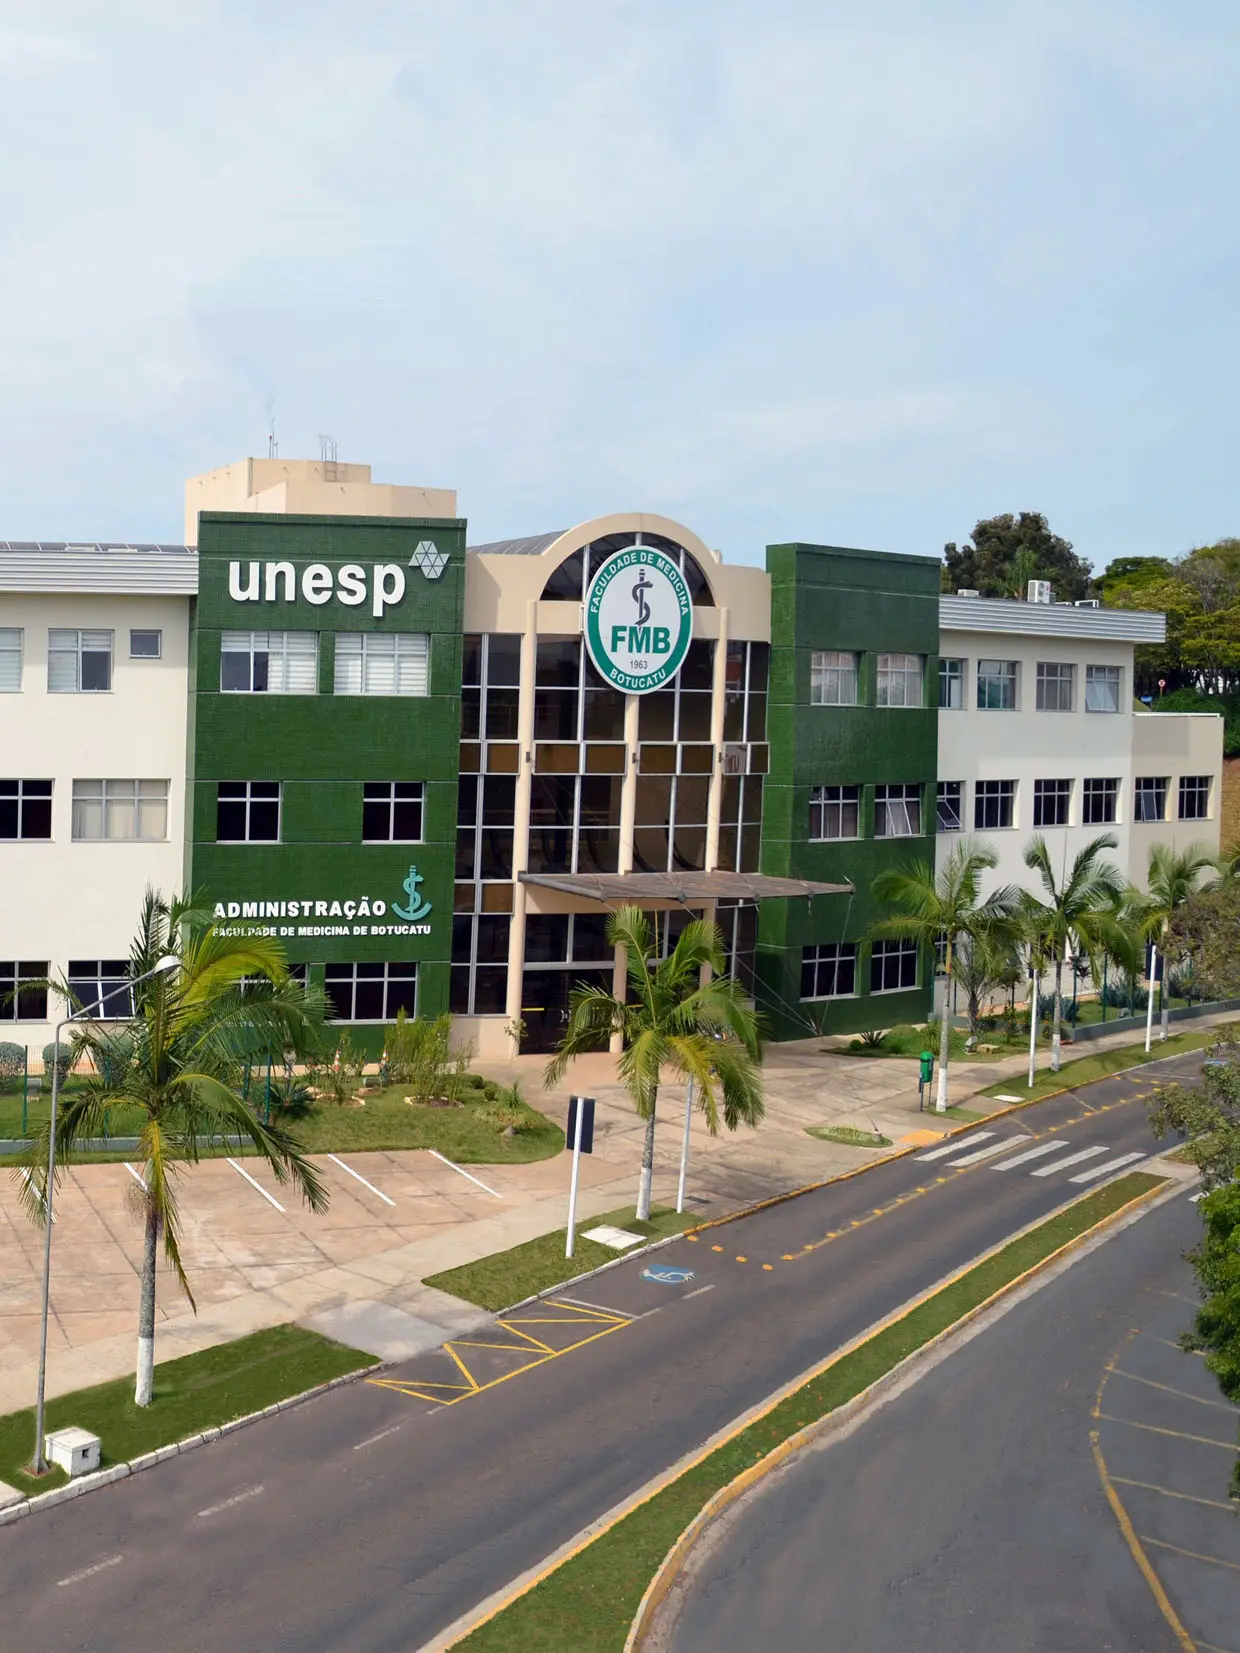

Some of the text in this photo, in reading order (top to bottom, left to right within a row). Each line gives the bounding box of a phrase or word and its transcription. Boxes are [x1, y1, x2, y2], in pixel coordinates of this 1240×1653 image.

[229, 561, 406, 617] unesp
[591, 552, 689, 615] FACULDADE DE MEDICINA
[611, 625, 671, 654] FMB
[629, 660, 648, 669] 1963
[610, 668, 666, 688] BOTUCATU
[213, 896, 386, 920] ADMINISTRAÇÃO
[280, 927, 295, 936] DE
[298, 926, 350, 936] MEDICINA
[353, 926, 368, 936] DE
[371, 925, 431, 935] BOTUCATU
